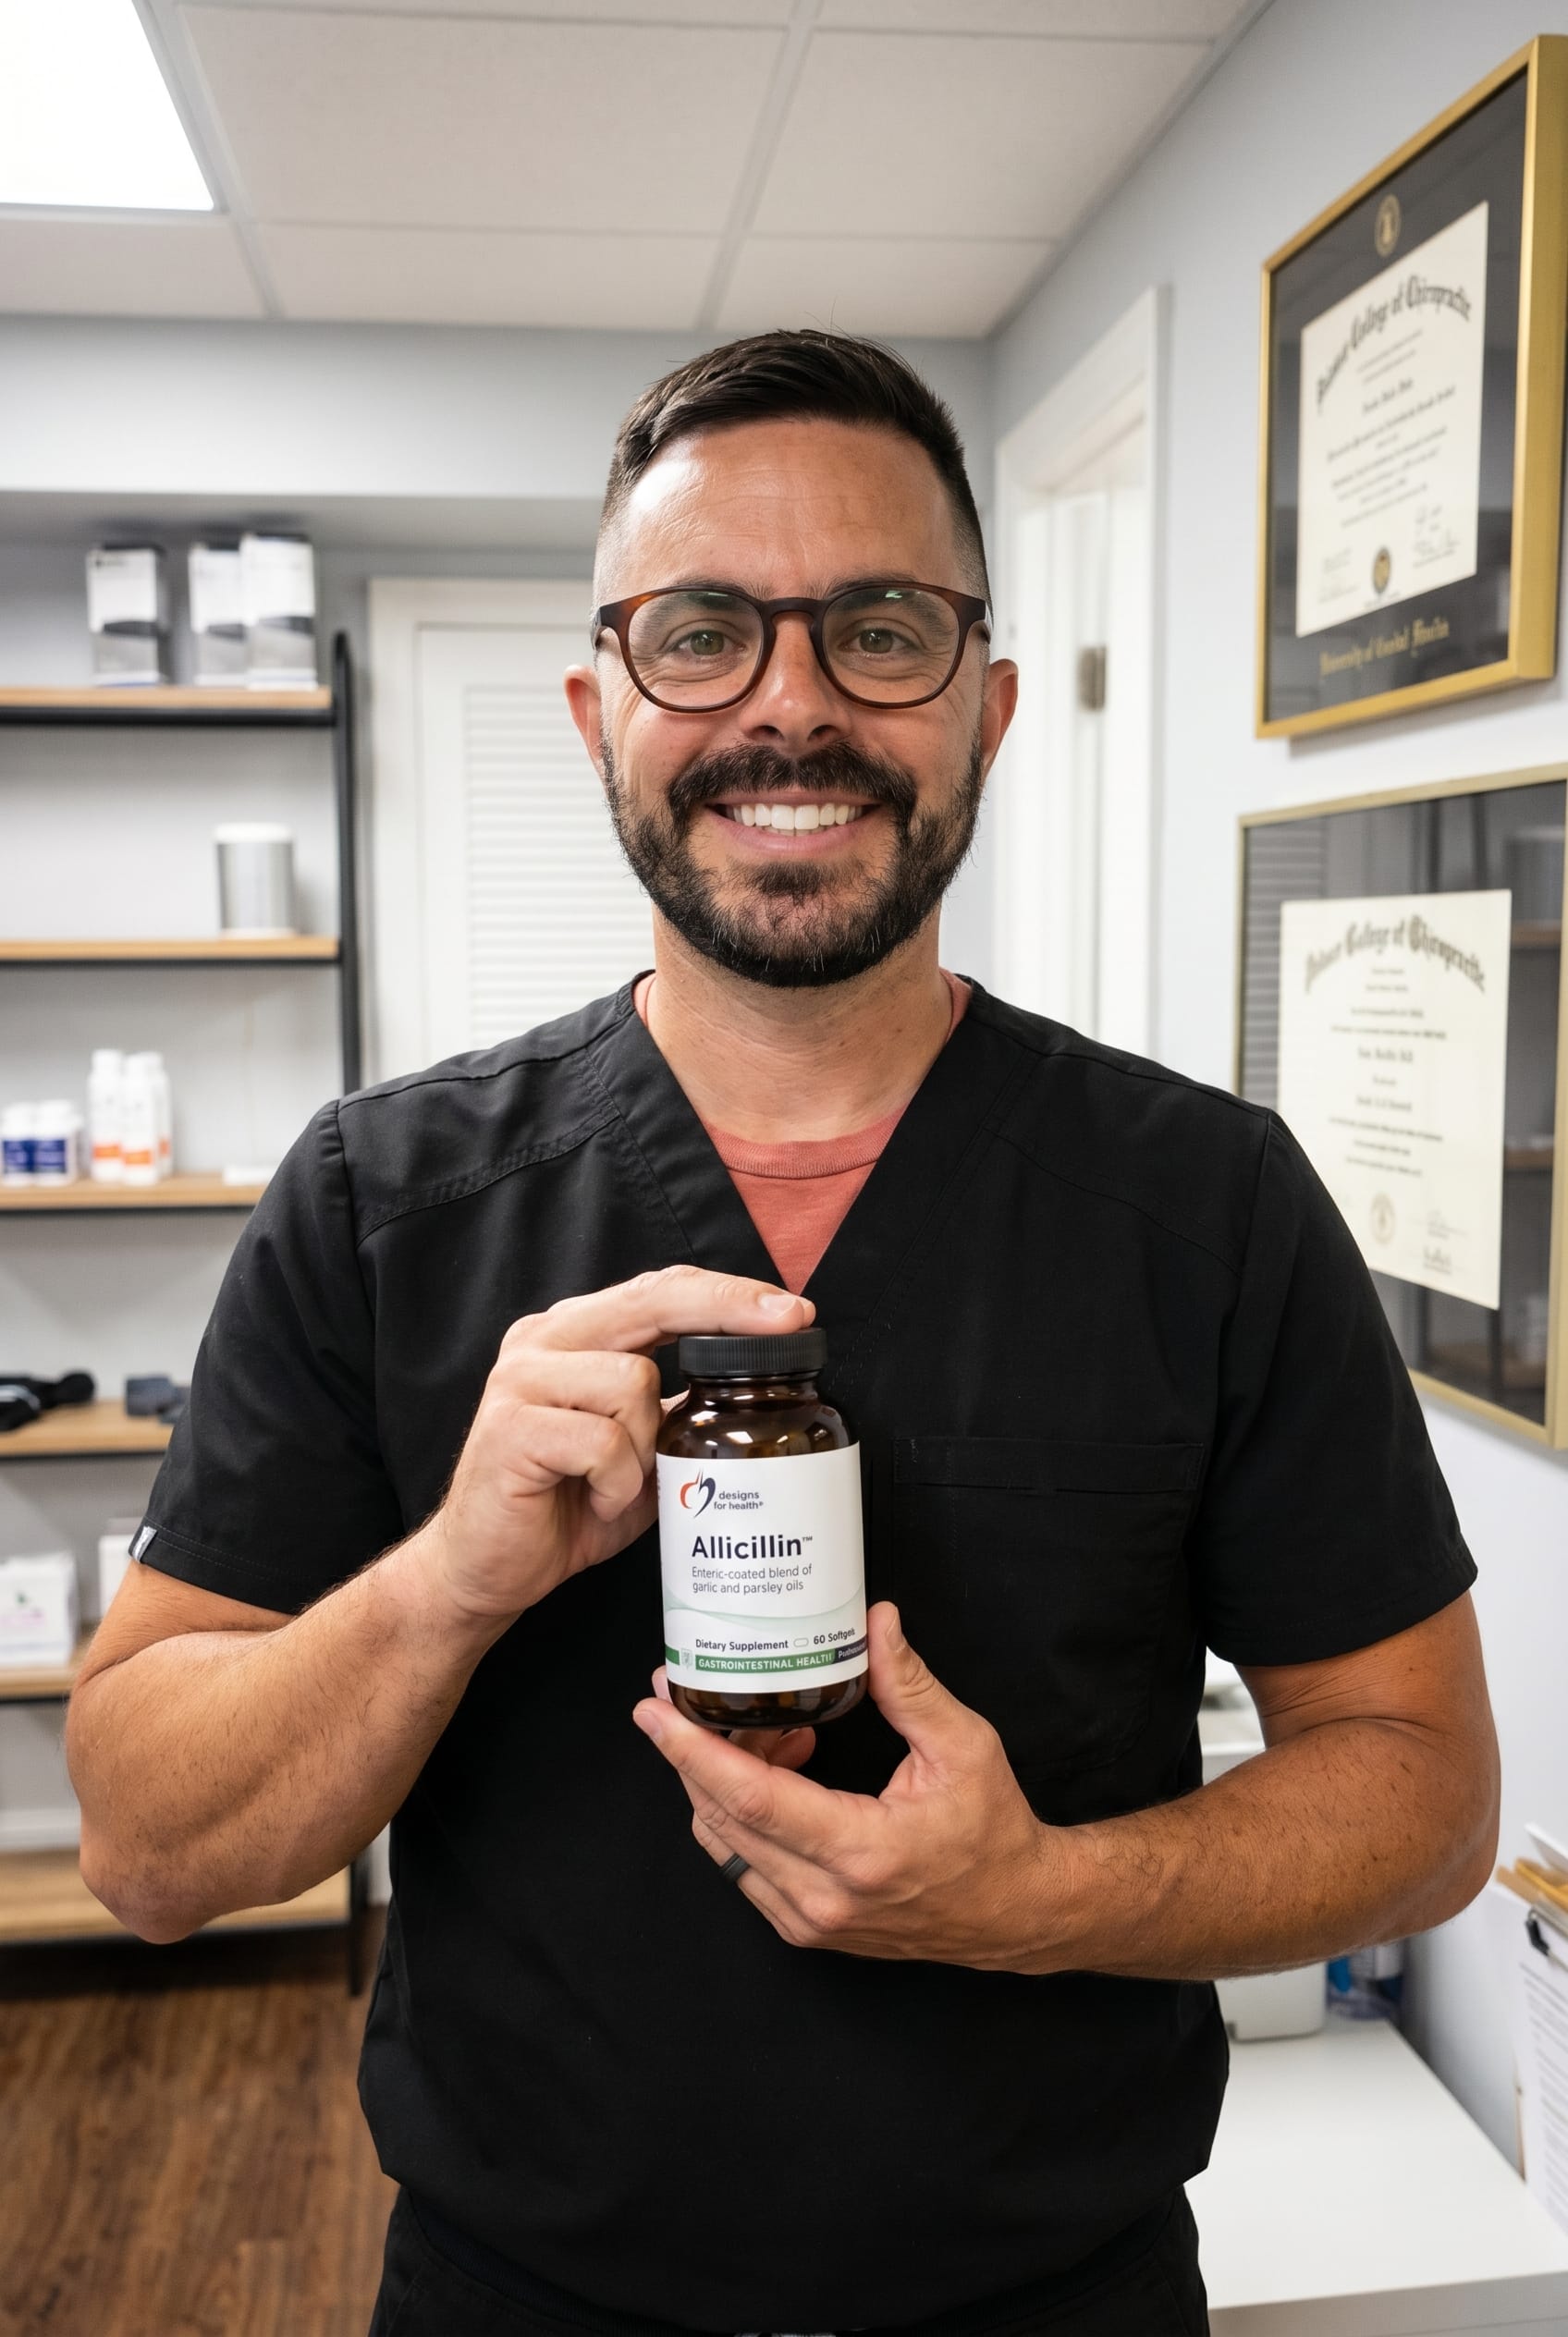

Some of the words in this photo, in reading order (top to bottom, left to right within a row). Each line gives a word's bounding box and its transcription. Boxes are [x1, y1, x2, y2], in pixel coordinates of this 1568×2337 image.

[718, 1490, 759, 1501] designs
[714, 1501, 727, 1510] for
[692, 1566, 766, 1580] Enteric-coated
[769, 1566, 799, 1578] blend
[802, 1563, 812, 1575] of
[692, 1582, 717, 1594] garlic
[720, 1583, 741, 1594] and
[743, 1582, 783, 1596] parsley
[786, 1580, 803, 1591] oils
[695, 1639, 727, 1652] Dietary
[729, 1640, 789, 1652] Supplement
[814, 1634, 826, 1645] 60
[698, 1658, 793, 1670] GASTROINTESTINAL
